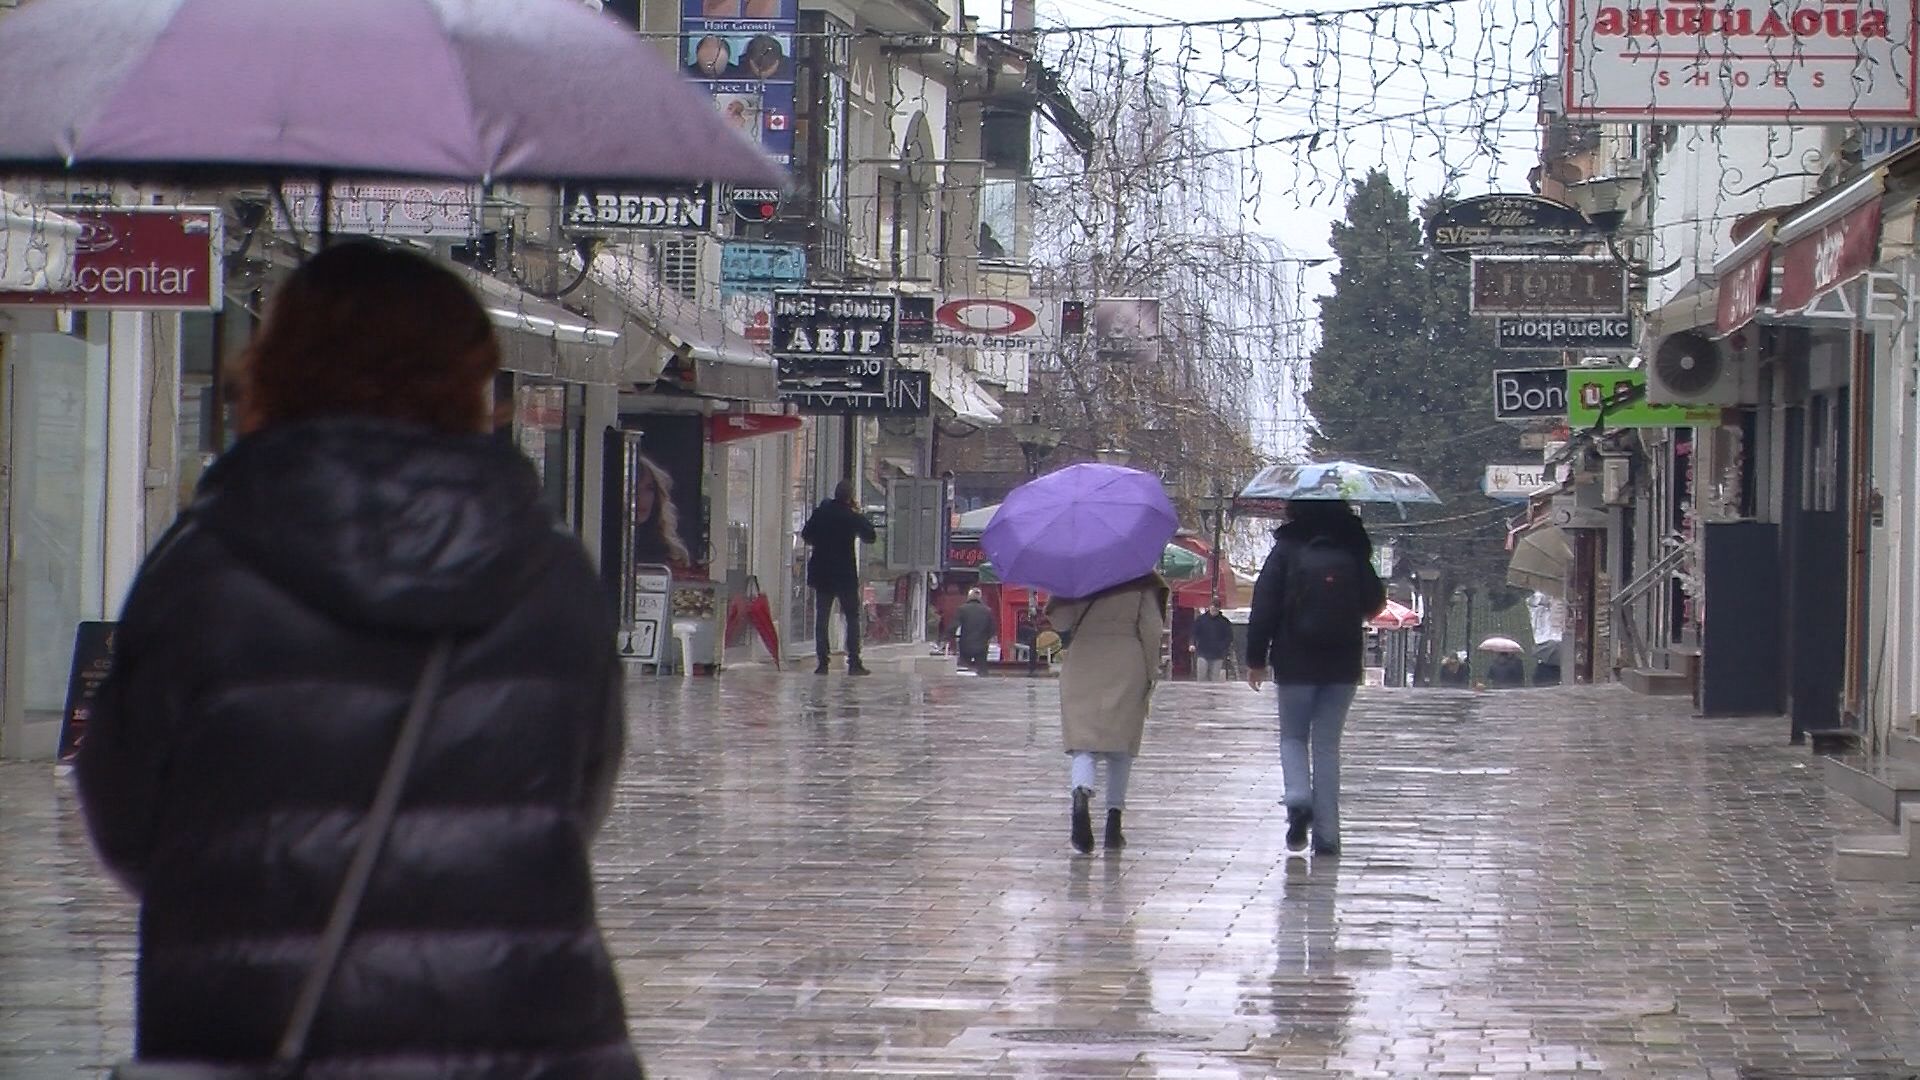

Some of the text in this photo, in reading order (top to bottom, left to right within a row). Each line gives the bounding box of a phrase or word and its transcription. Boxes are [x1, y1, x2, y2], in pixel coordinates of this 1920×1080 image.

[704, 21, 728, 31] Hair
[1658, 71, 1825, 88] SHOES
[570, 194, 706, 227] ABEDIN
[1501, 378, 1568, 411] Bon
